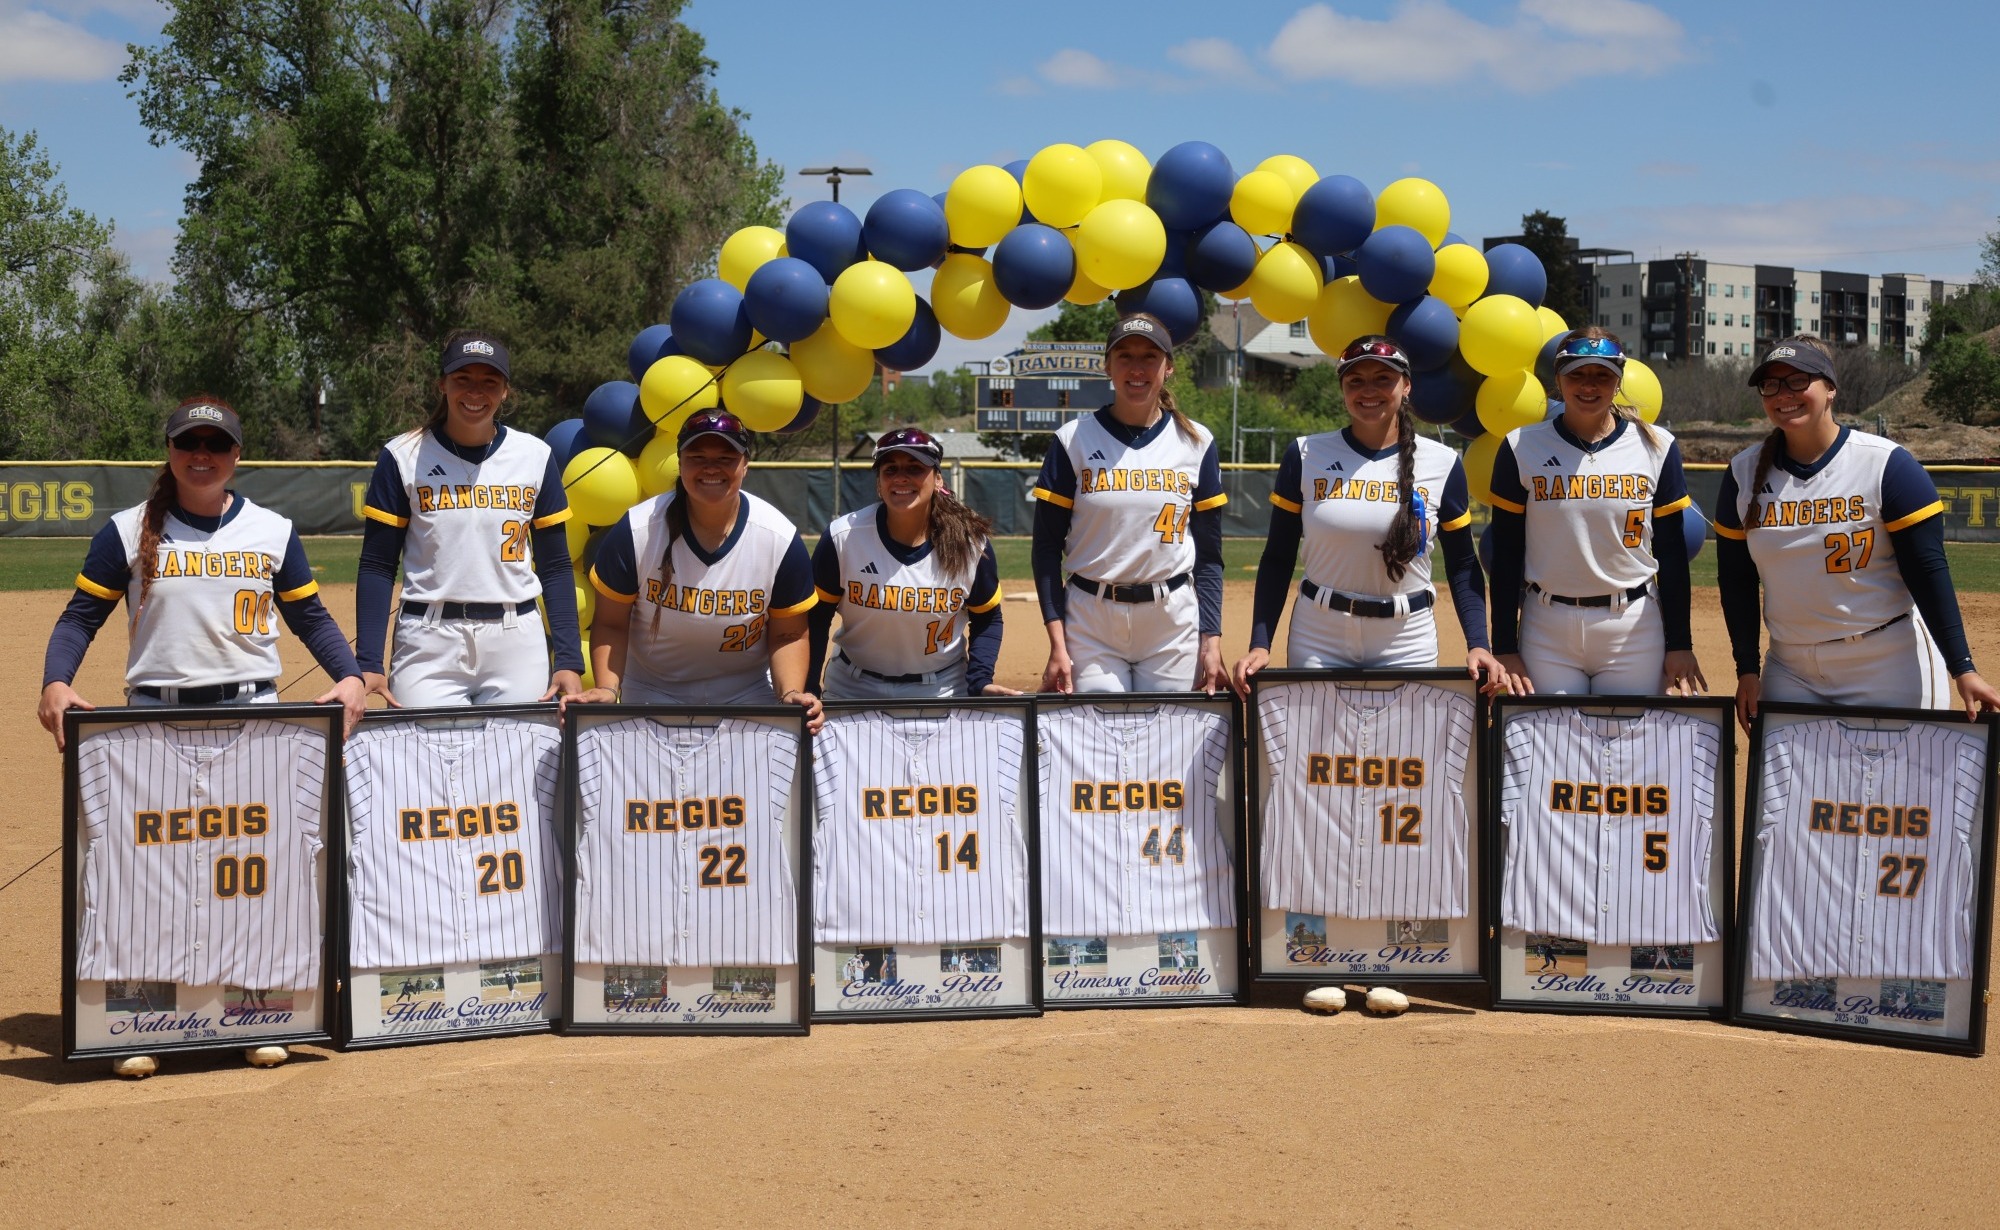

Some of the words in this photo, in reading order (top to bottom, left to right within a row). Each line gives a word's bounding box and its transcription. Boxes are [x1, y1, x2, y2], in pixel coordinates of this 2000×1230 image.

[1018, 355, 1105, 372] RANGER
[1054, 343, 1105, 351] UNIVERSITY
[989, 378, 1015, 390] REGIS
[1048, 379, 1080, 390] INNING
[987, 410, 1008, 422] BALL
[1026, 411, 1056, 422] STRIKE
[416, 484, 537, 513] RANGERS
[1081, 467, 1190, 495] RANGERS
[1532, 474, 1649, 501] RANGERS
[1153, 502, 1191, 544] 44
[1623, 508, 1646, 549] 5
[1824, 527, 1875, 574] 27
[233, 588, 272, 635] 00
[646, 578, 765, 615] RANGERS
[848, 580, 963, 613] RANGERS
[719, 614, 765, 653] 22
[924, 613, 957, 655] 14
[1307, 752, 1425, 790] REGIS
[625, 794, 746, 833] REGIS
[862, 783, 980, 820] REGIS
[1072, 779, 1185, 813] REGIS
[1550, 779, 1670, 817] REGIS
[135, 803, 269, 846] REGIS
[399, 801, 520, 842] REGIS
[1379, 802, 1423, 846] 12
[1809, 797, 1931, 840] REGIS
[935, 830, 981, 873] 14
[1140, 824, 1186, 866] 44
[1643, 830, 1670, 874] 5
[214, 853, 268, 900] 00
[476, 849, 525, 896] 20
[698, 843, 749, 888] 22
[1877, 852, 1929, 899] 27
[1288, 945, 1368, 963] Olivia
[1378, 945, 1452, 963] Wick
[1349, 964, 1366, 973] 2023
[1372, 964, 1390, 973] 2026
[842, 979, 927, 1001] Caitlyn
[935, 974, 1003, 993] Potts
[1054, 970, 1132, 989] Vanessa
[1531, 972, 1606, 992] Bella
[1615, 974, 1696, 995] Porter
[381, 999, 454, 1024] Hallie
[457, 992, 548, 1021] Crappell
[688, 993, 773, 1018] Ingram
[1594, 993, 1610, 1001] 2023
[1615, 993, 1631, 1002] 2026
[1770, 987, 1838, 1011] Bella
[110, 1012, 212, 1035] Natasha
[219, 1006, 295, 1027] Ellison
[1835, 1013, 1849, 1023] 2025
[1854, 1015, 1869, 1025] 2026
